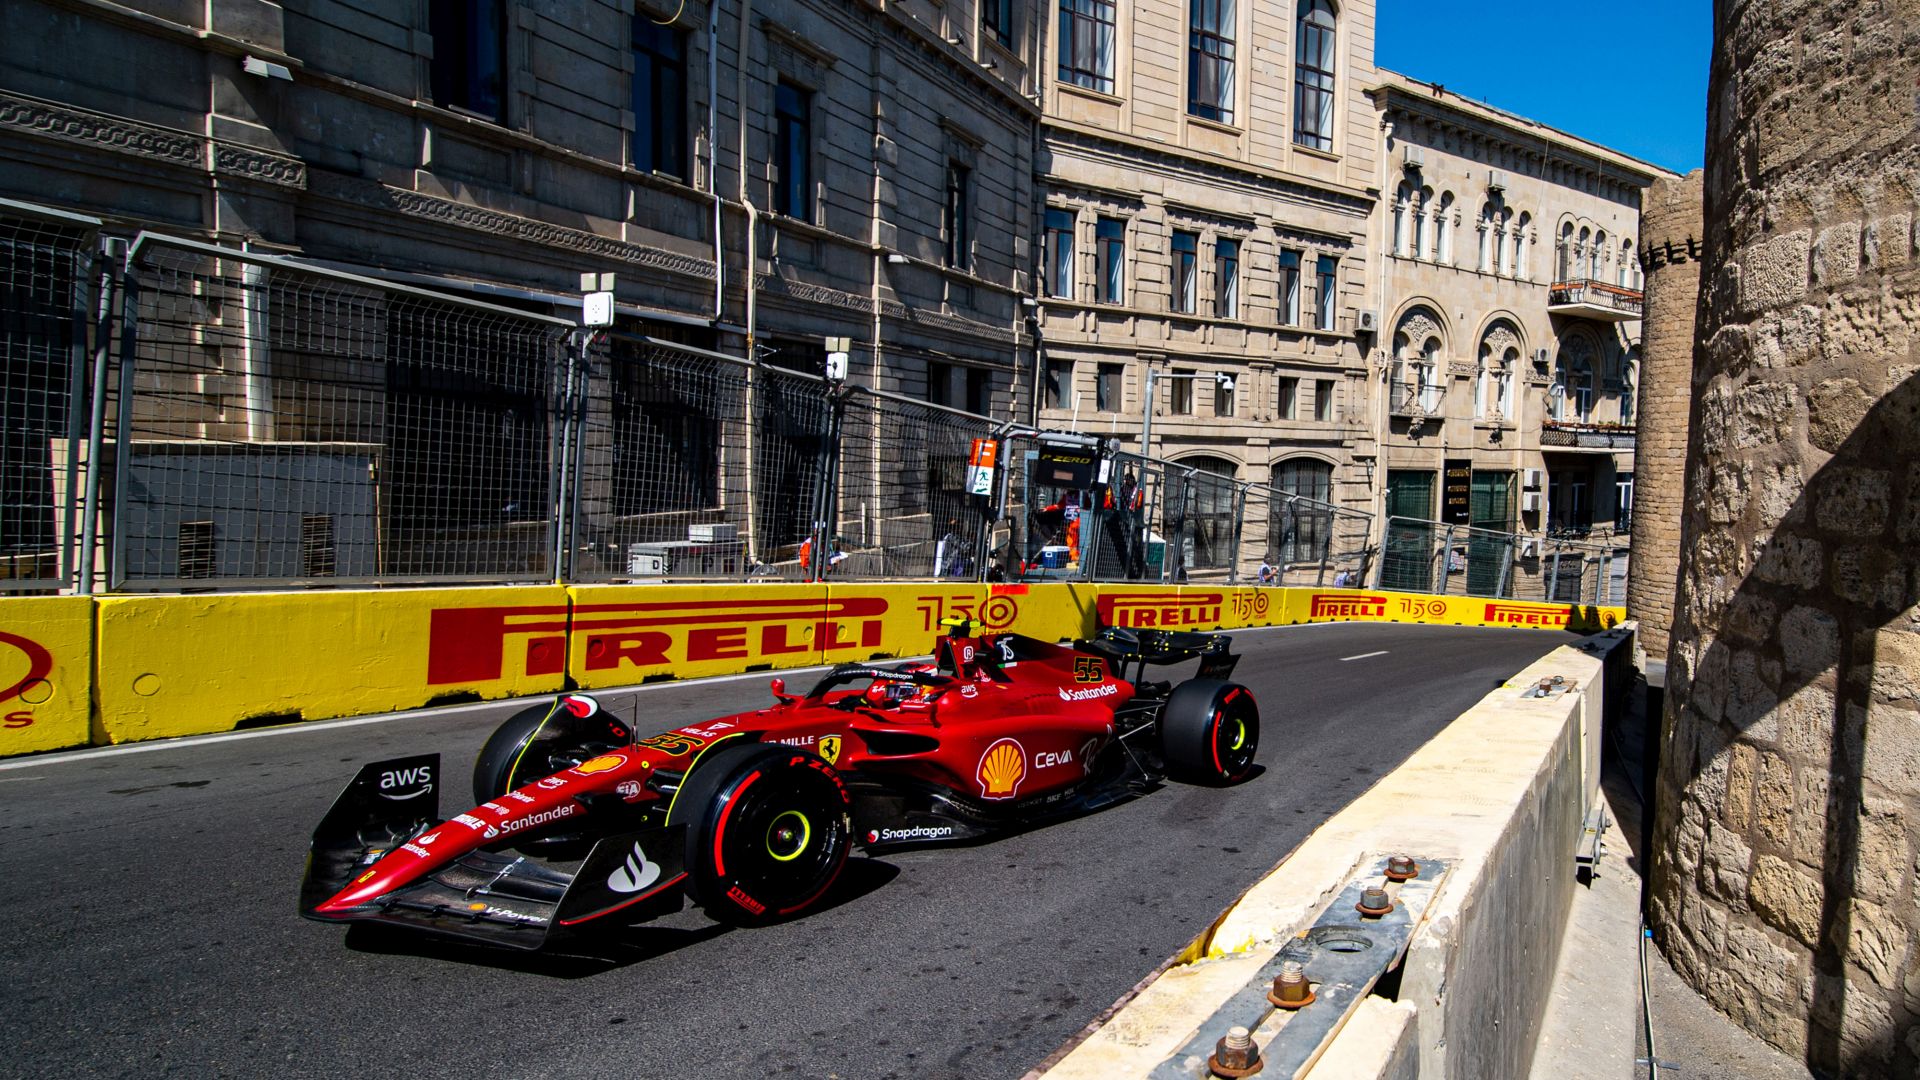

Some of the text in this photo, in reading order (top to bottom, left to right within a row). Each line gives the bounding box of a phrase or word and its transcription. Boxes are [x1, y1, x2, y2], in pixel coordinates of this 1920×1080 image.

[1052, 455, 1091, 464] ZERO
[1095, 594, 1223, 628] PIRELLI
[1232, 592, 1269, 621] 150
[1310, 594, 1387, 617] PIRELLI
[1400, 598, 1446, 618] 150
[1484, 603, 1575, 626] PIRELLI
[427, 597, 889, 685] PIRELLI
[878, 671, 914, 681] Snapdragon
[1073, 656, 1104, 684] 55
[961, 684, 977, 694] aws
[1067, 683, 1118, 701] Santander
[380, 765, 432, 789] aws
[501, 803, 575, 835] Santander
[882, 825, 952, 840] Snapdragon
[486, 906, 548, 923] V-Power
